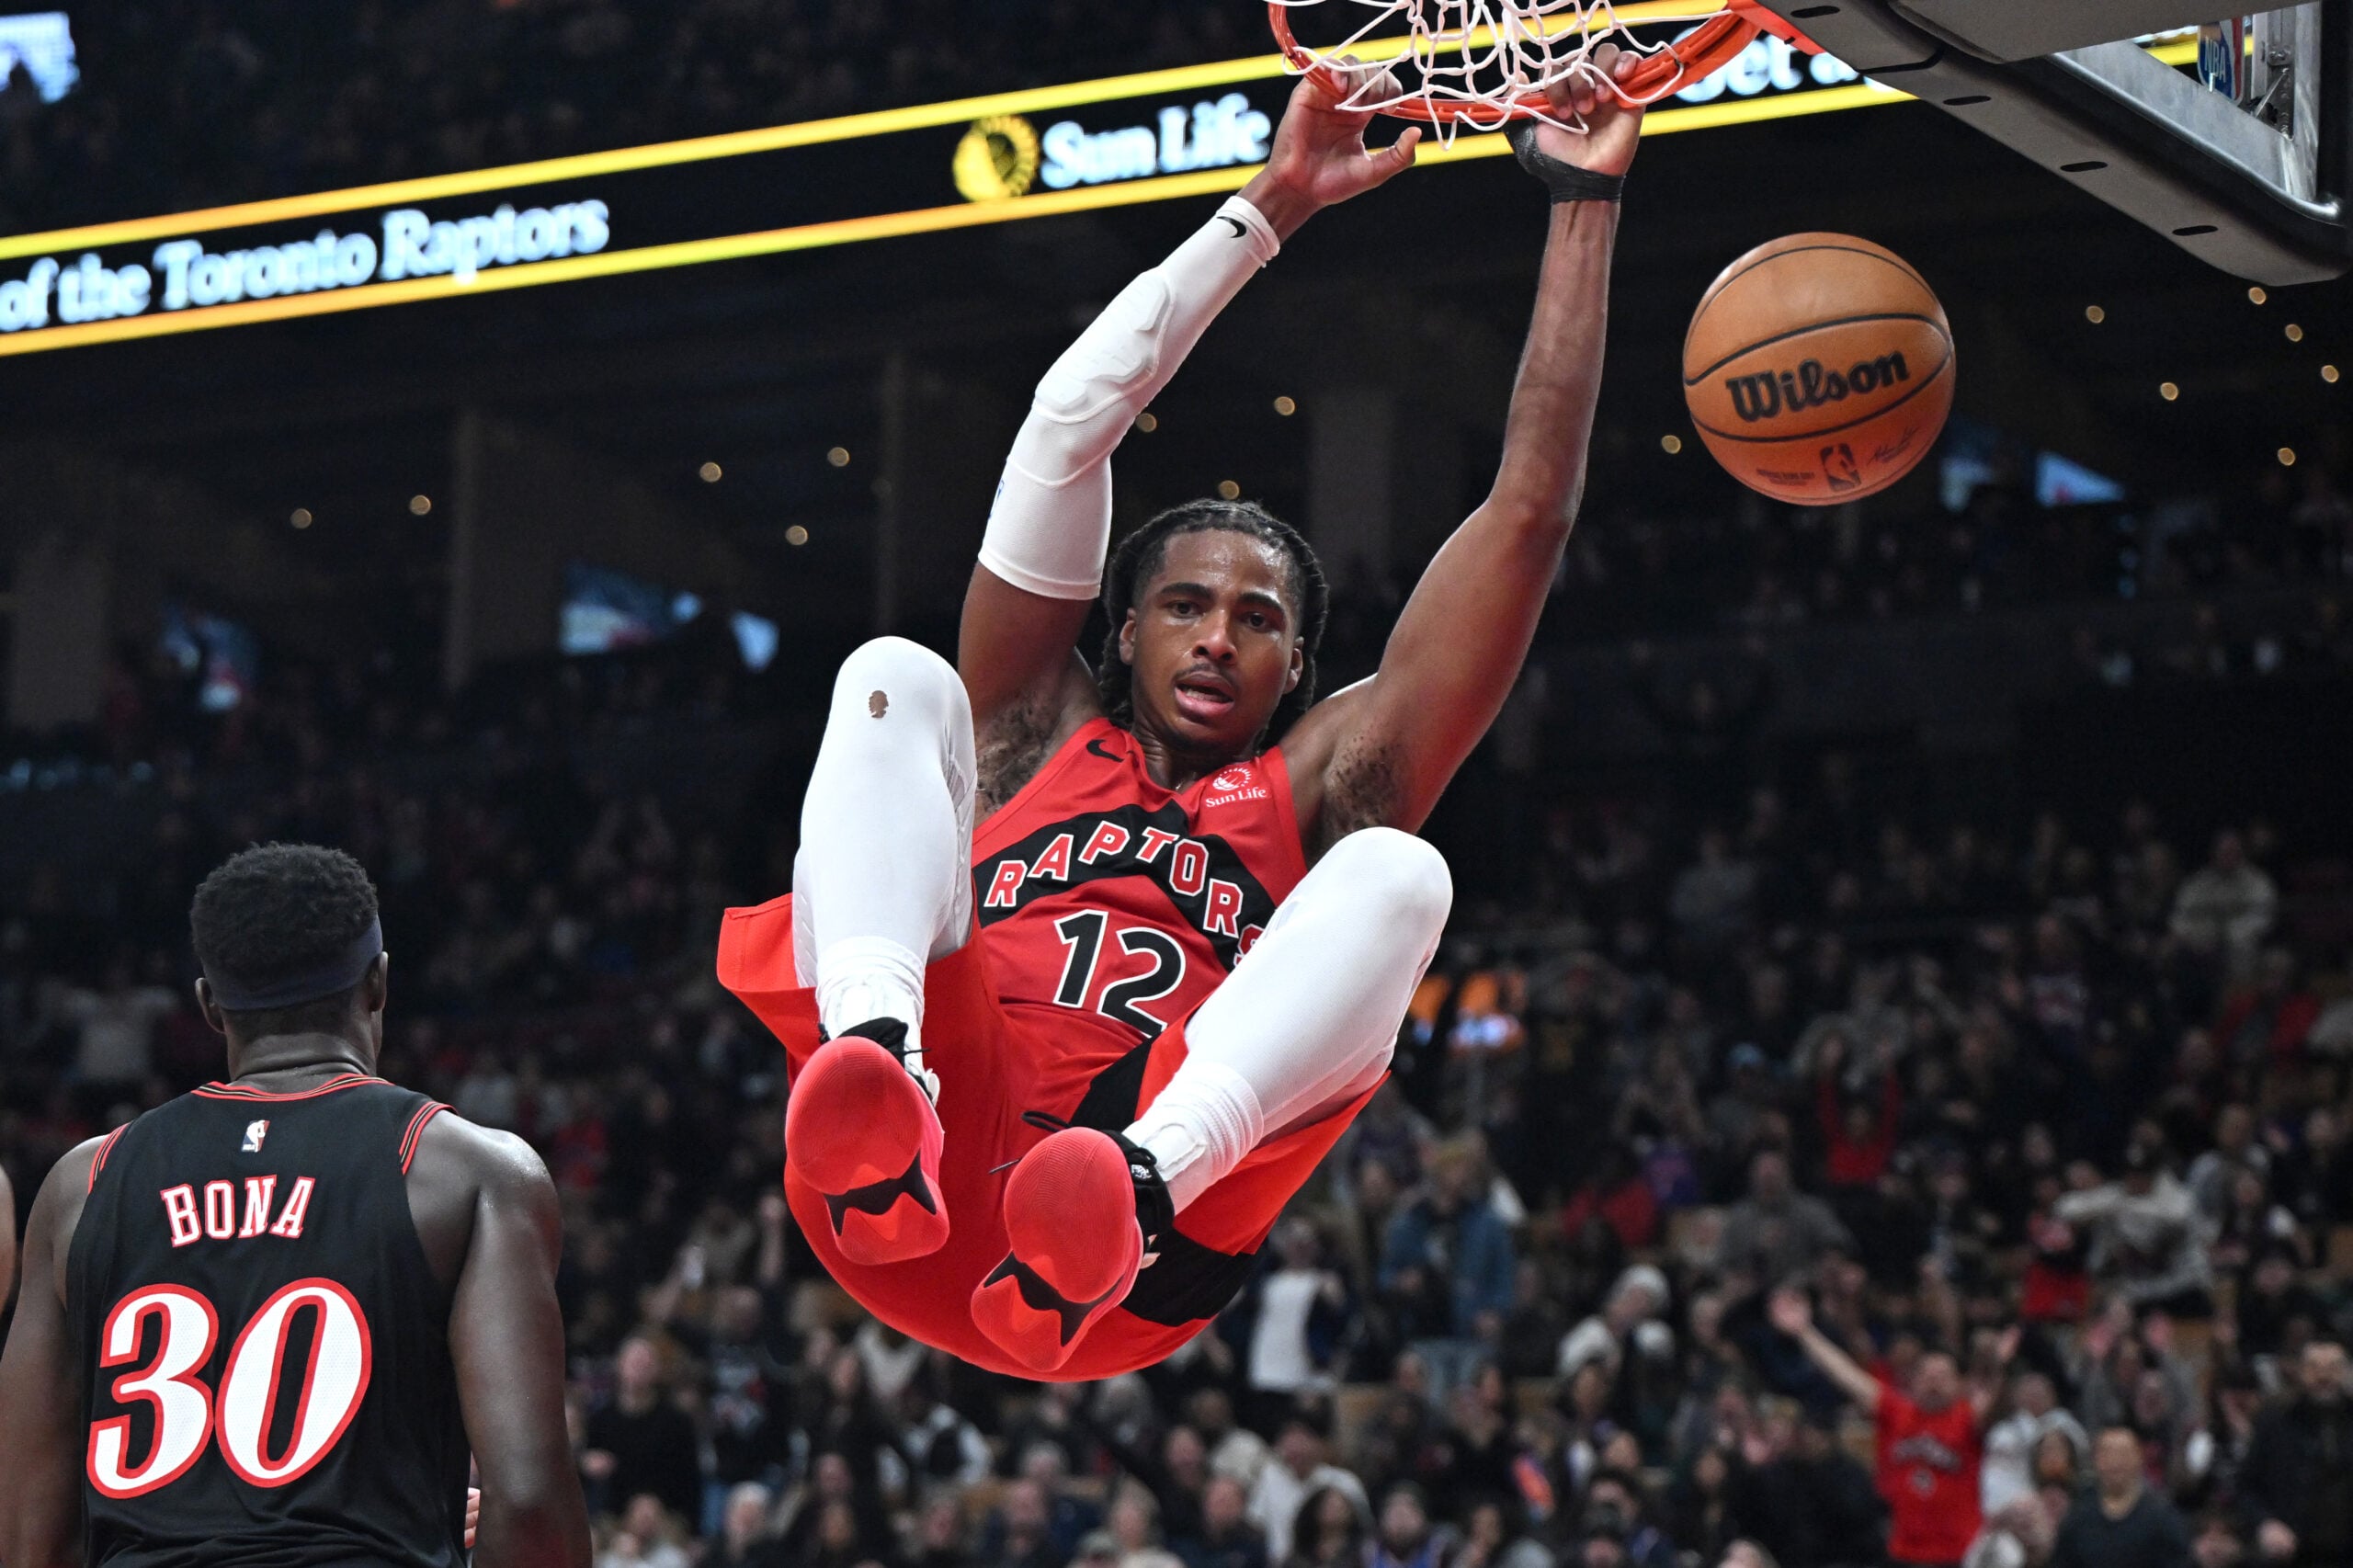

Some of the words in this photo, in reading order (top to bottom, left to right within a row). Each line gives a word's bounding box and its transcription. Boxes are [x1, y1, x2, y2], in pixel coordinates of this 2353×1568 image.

[1040, 120, 1157, 189] Sun
[1157, 93, 1271, 174] Life
[0, 257, 58, 332] of
[57, 252, 151, 323] the
[153, 230, 377, 310] Toronto
[381, 199, 609, 285] Raptors
[1725, 350, 1911, 423] Wilson
[1205, 794, 1236, 808] Sun
[1237, 786, 1267, 801] Life
[1053, 909, 1187, 1039] 12
[160, 1175, 315, 1247] BONA
[86, 1277, 373, 1500] 30
